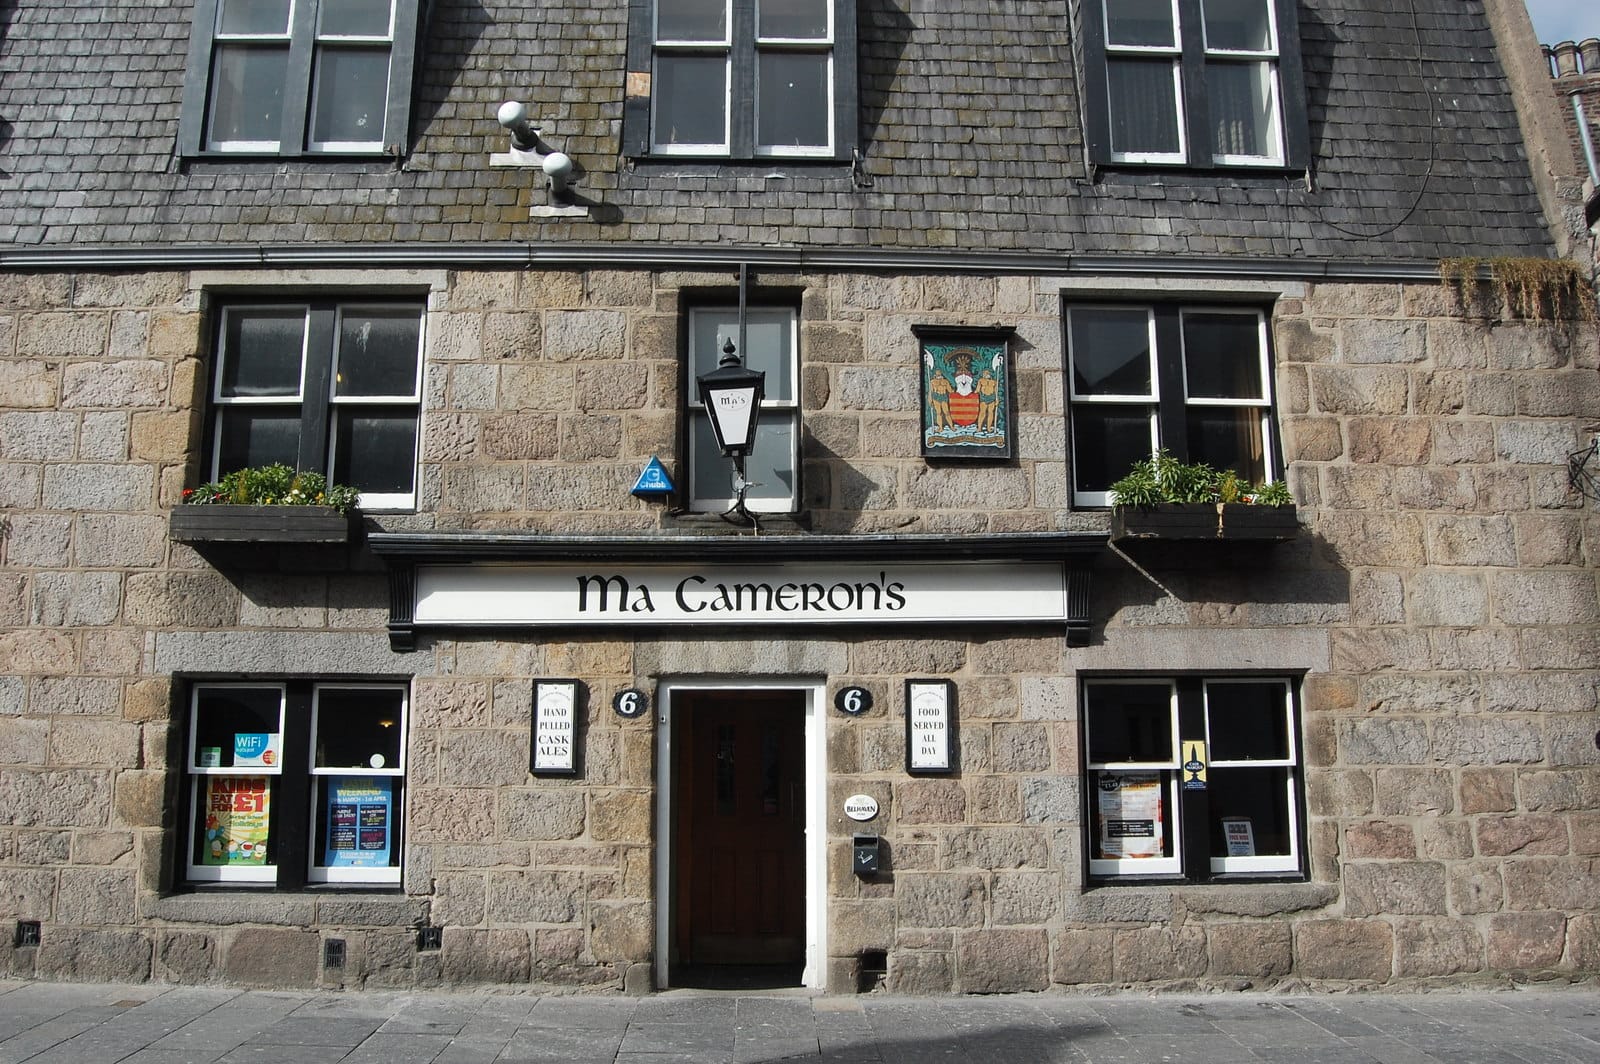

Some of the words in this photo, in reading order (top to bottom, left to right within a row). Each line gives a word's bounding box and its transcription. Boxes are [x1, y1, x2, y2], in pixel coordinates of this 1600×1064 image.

[575, 574, 656, 613] Ma
[675, 571, 906, 613] Cameron's
[620, 692, 638, 714] 6
[844, 690, 861, 711] 6
[543, 707, 567, 717] HAND
[918, 707, 940, 717] FOOD
[539, 721, 570, 730] PULLED
[913, 721, 944, 730] SERVED
[236, 736, 261, 748] WiFi
[538, 735, 569, 745] CASK
[922, 734, 937, 743] ALL
[539, 746, 568, 756] ALES
[921, 746, 937, 755] DAY
[212, 778, 266, 794] KIDS
[211, 794, 232, 804] EAT
[233, 793, 264, 813] £1
[211, 803, 233, 812] FOR
[846, 805, 876, 813] BELHAVEN
